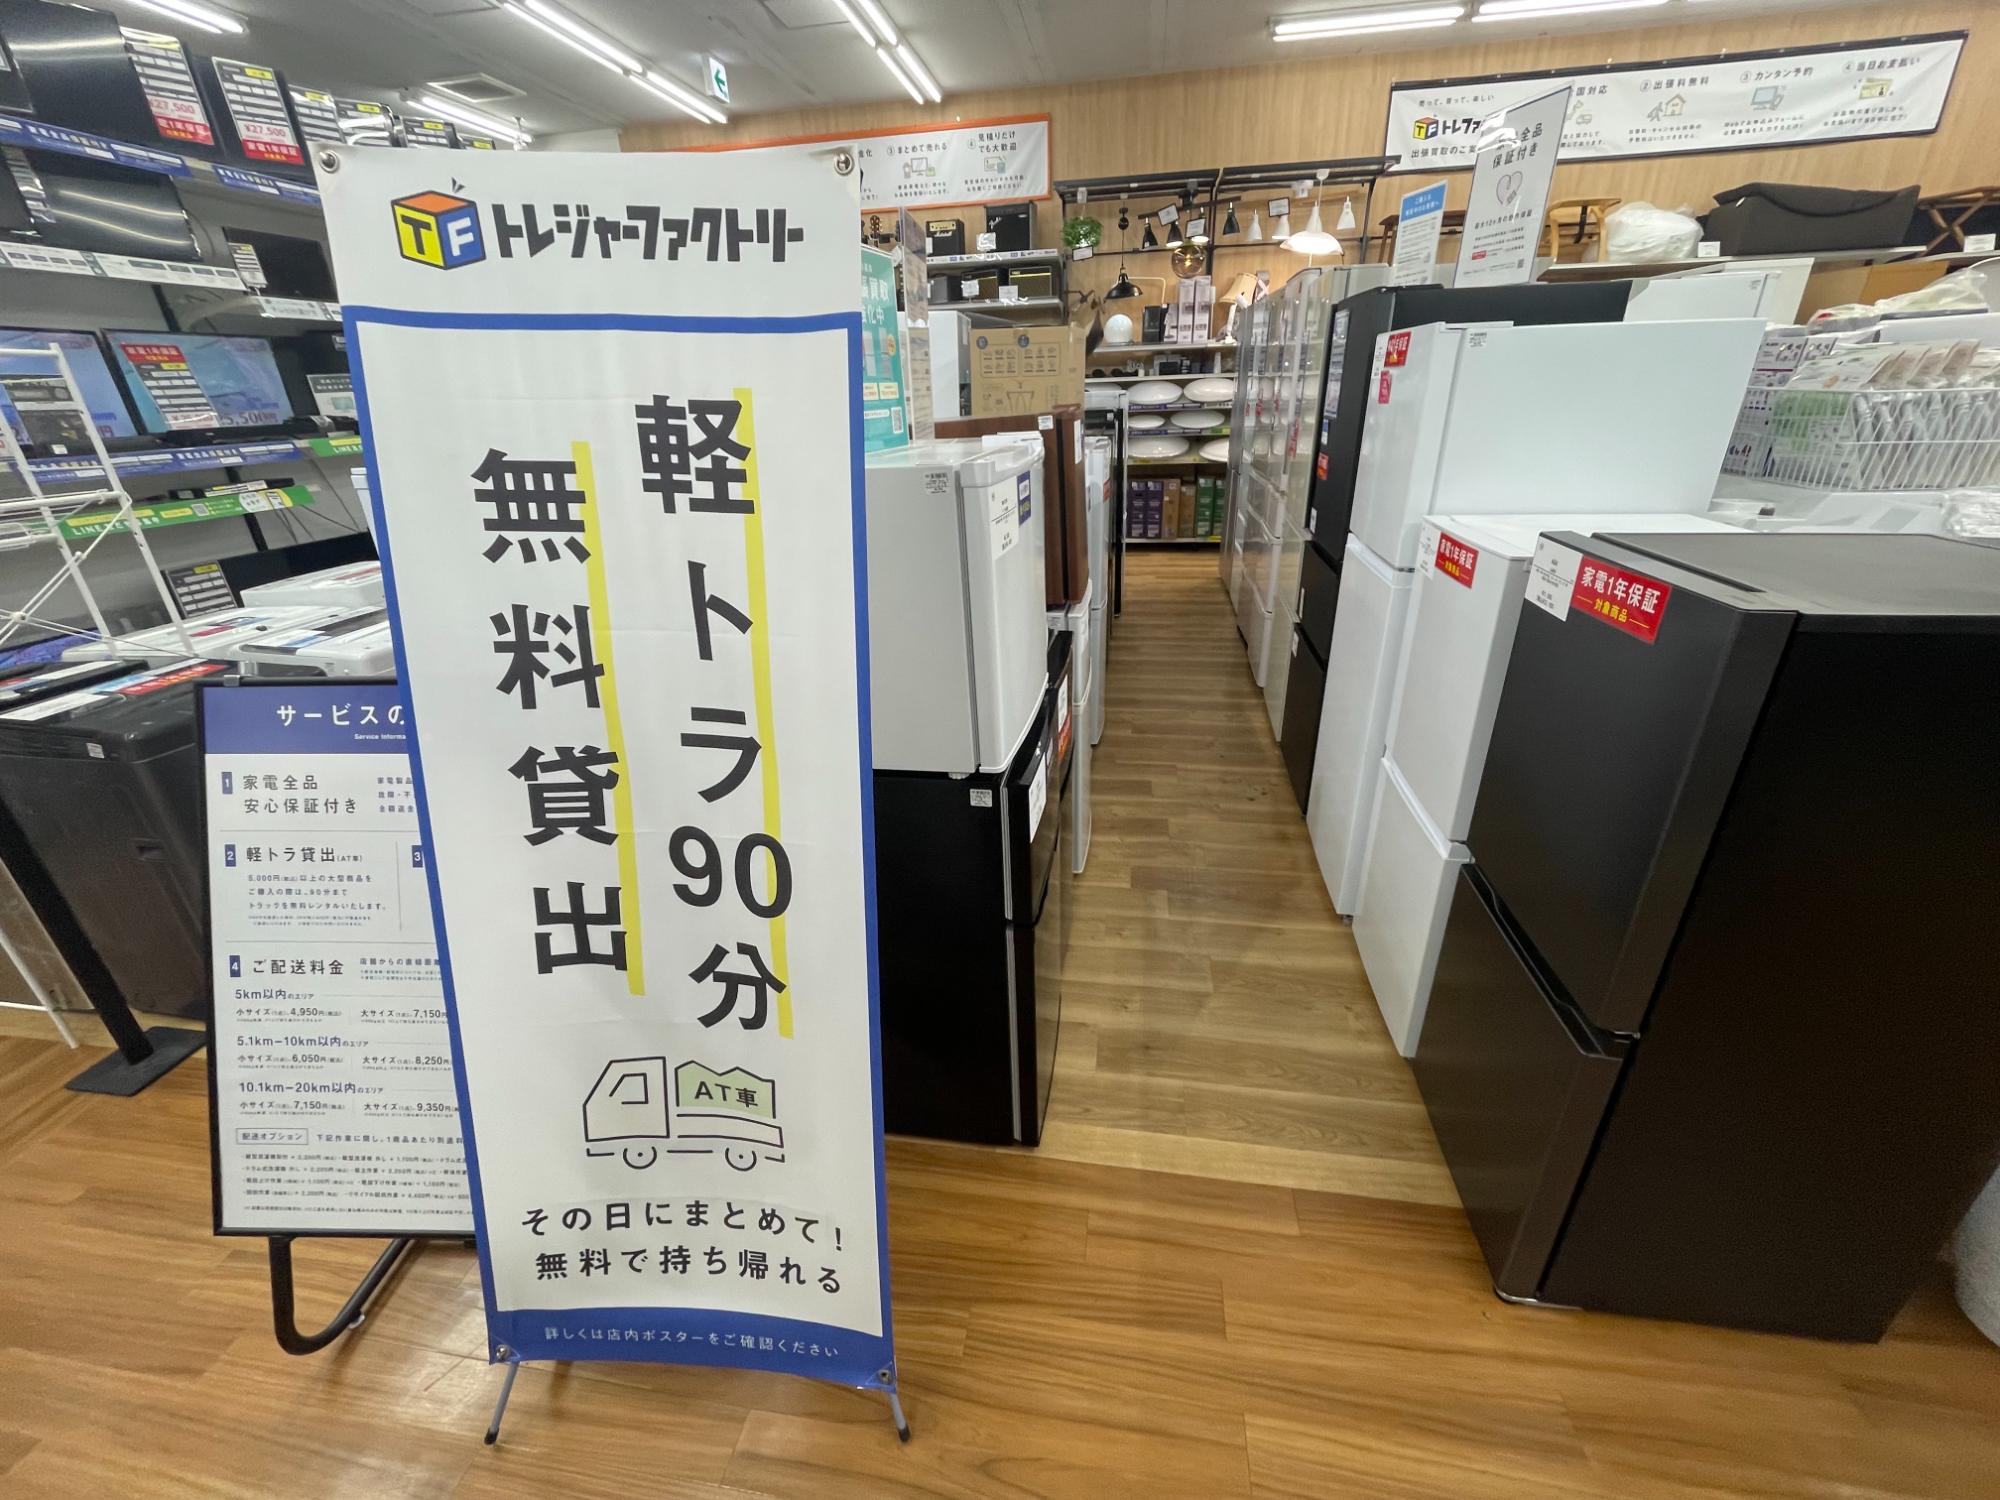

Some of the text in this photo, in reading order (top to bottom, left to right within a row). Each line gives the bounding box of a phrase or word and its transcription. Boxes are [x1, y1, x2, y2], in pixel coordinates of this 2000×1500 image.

[1569, 85, 1609, 98] 国対応
[1442, 117, 1484, 136] トレファ
[1492, 144, 1538, 169] 保証付き
[491, 203, 805, 263] トレジャーファクトリー
[1580, 565, 1663, 614] 家電1年保証
[1593, 597, 1629, 623] 対象商品
[276, 702, 405, 727] サービスの
[470, 447, 629, 975] 無料貸出
[635, 393, 793, 1032] 軽トラ90分
[242, 774, 319, 791] 家電全品
[243, 797, 357, 814] 安心保証付き
[252, 959, 344, 975] ご配送料金
[693, 1080, 759, 1108] AT車
[521, 1200, 843, 1251] その日にまとめて!
[535, 1244, 842, 1294] 無料で持ち帰れる
[544, 1325, 840, 1358] 詳しくは店内ポスターをご確認ください
